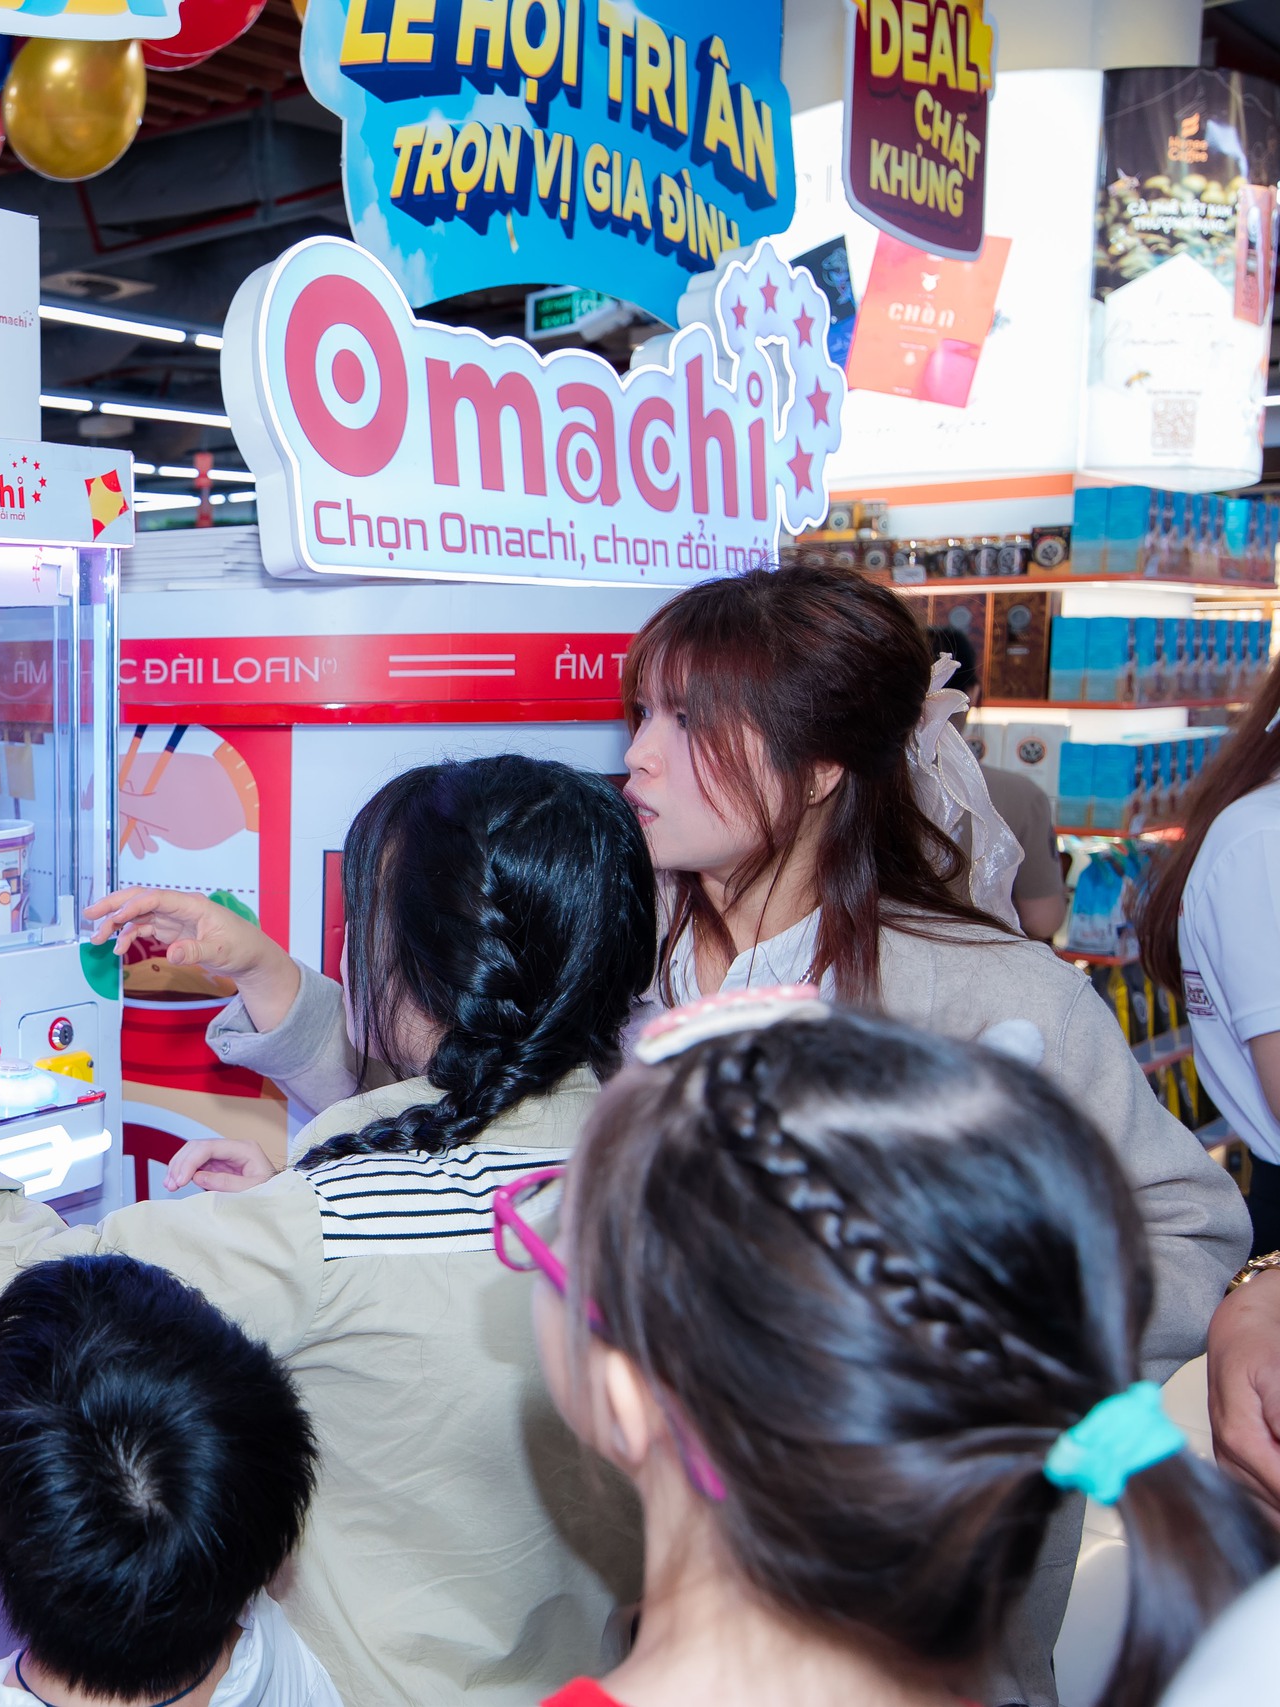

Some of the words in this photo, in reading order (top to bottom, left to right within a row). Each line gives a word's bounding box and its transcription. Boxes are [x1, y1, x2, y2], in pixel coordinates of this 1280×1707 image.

[870, 0, 979, 93] DEAL
[598, 0, 689, 136] TRI
[704, 36, 778, 200] ÂN
[915, 90, 981, 181] CHẤT
[390, 121, 523, 211] TRỌN
[533, 129, 575, 220] VỊ
[583, 143, 652, 231] GIA
[658, 168, 740, 265] ĐÌNH
[869, 138, 964, 218] KHỦNG
[284, 273, 769, 521] Omachi
[314, 498, 429, 561] Chọn
[440, 511, 587, 570] Omachi,
[593, 531, 670, 576] chọn
[677, 519, 717, 572] đổi
[142, 653, 203, 684] ĐÀI
[555, 643, 604, 679] ẨM
